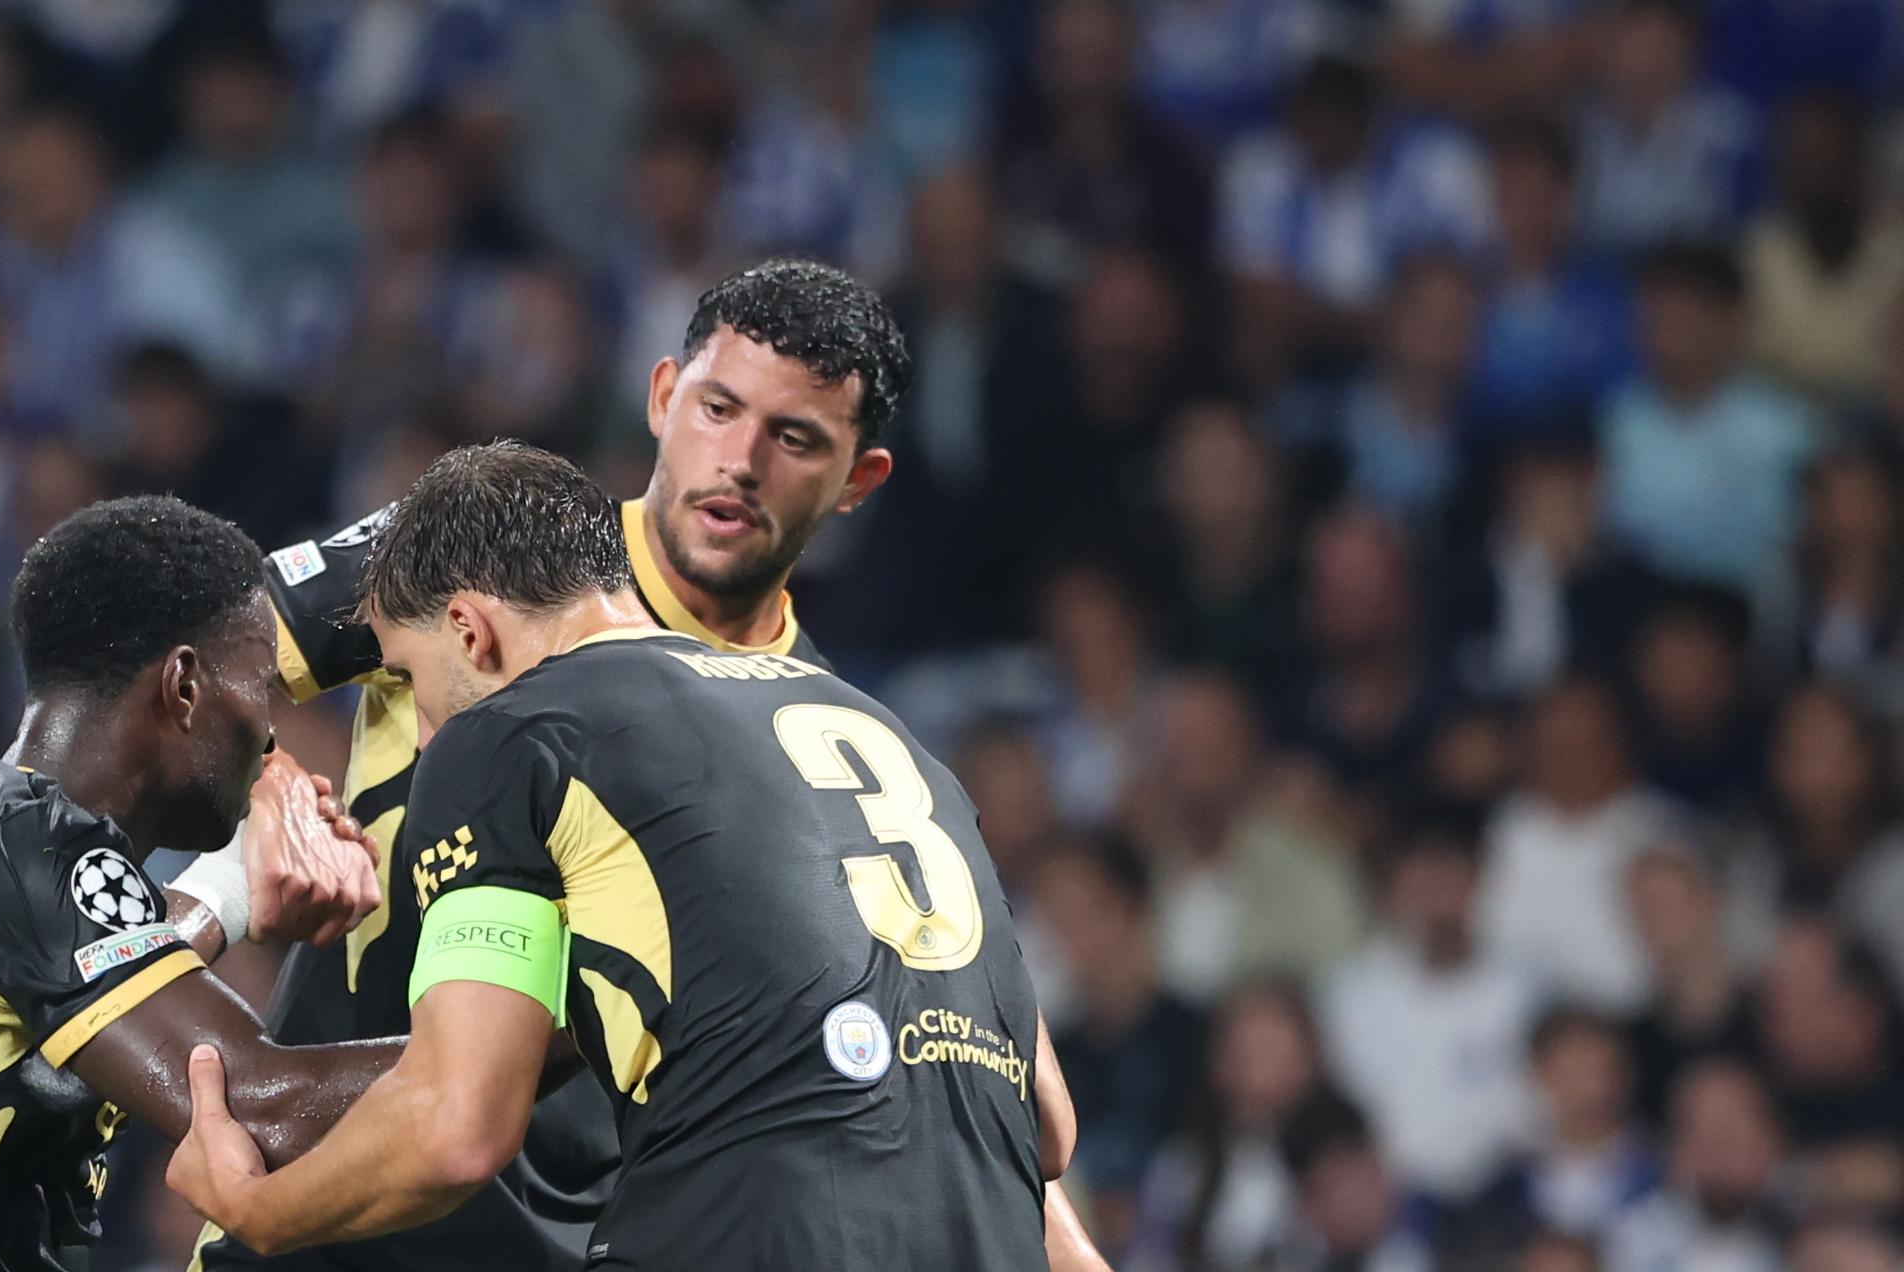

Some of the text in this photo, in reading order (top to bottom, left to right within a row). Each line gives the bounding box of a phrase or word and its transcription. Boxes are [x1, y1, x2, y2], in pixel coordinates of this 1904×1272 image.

[772, 703, 984, 972] 3
[434, 925, 533, 953] RESPECT
[919, 1008, 1000, 1046] City in the
[899, 1023, 1028, 1102] Community
